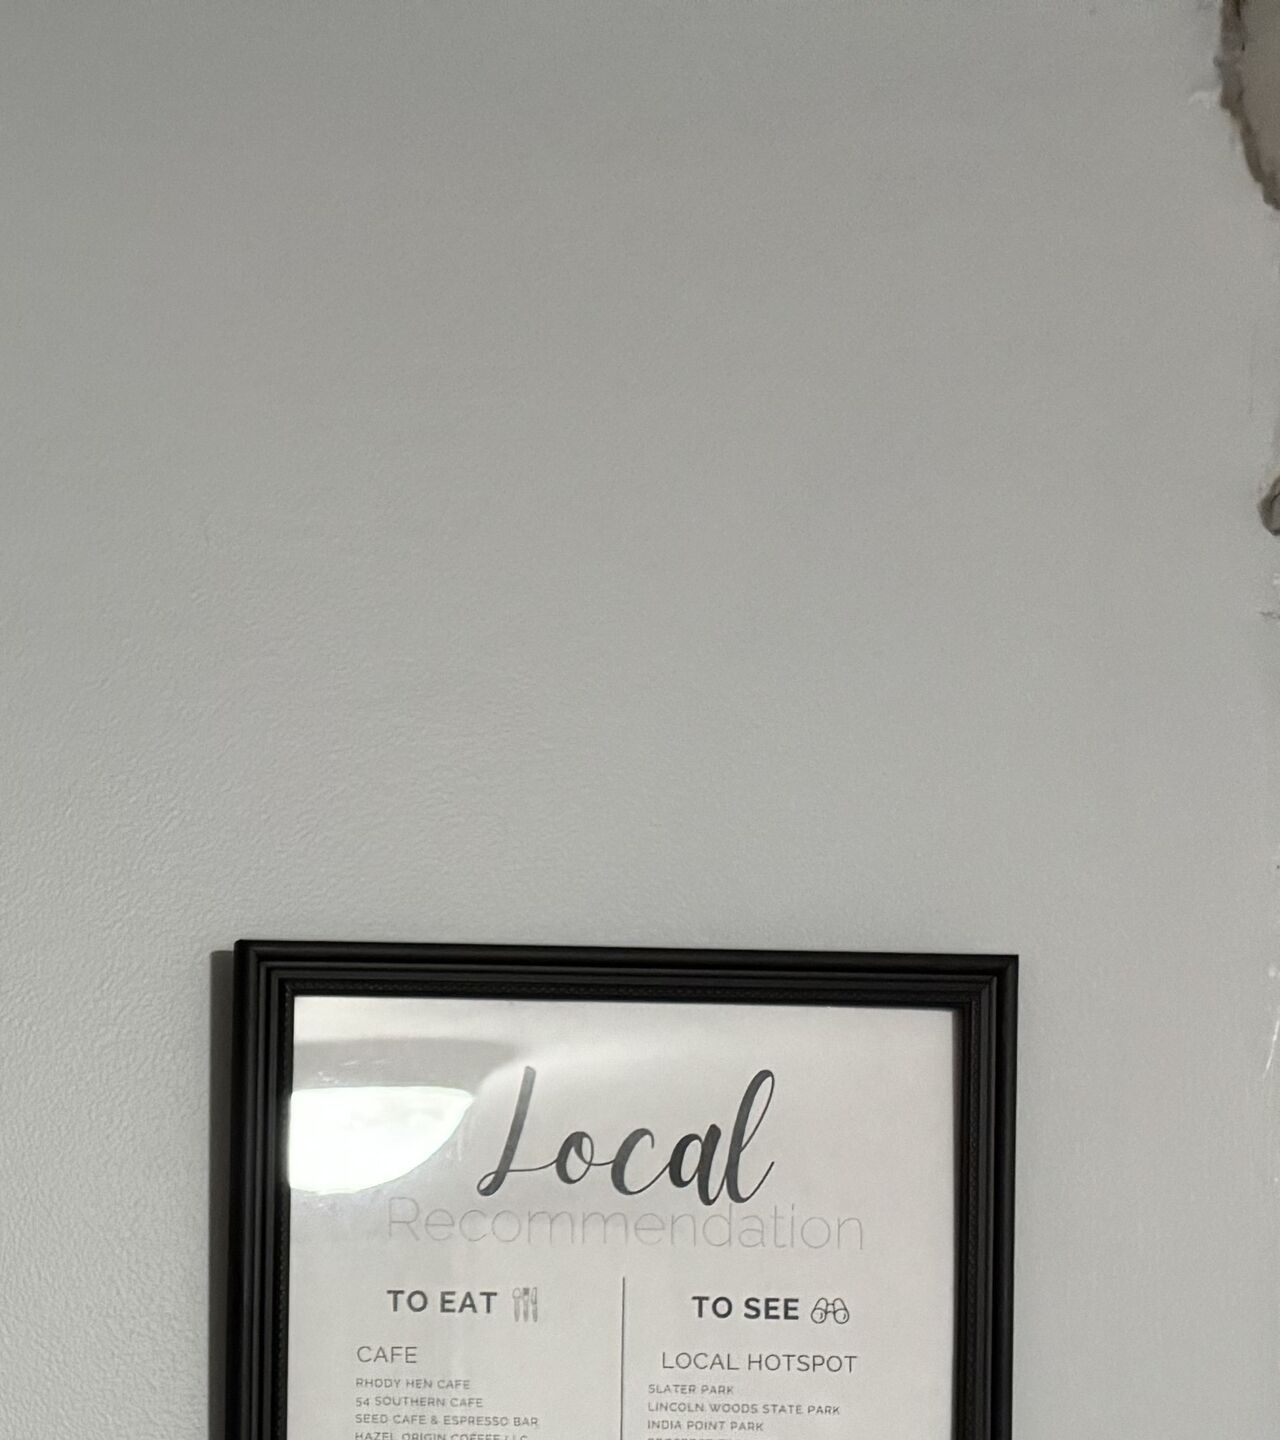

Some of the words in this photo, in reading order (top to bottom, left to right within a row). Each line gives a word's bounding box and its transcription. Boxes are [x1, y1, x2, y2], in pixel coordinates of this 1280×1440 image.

[477, 1066, 775, 1207] Local
[386, 1197, 865, 1250] Recommendation
[386, 1289, 429, 1313] TO
[439, 1290, 499, 1315] EAT
[690, 1295, 733, 1319] TO
[743, 1296, 800, 1321] SEE
[356, 1345, 418, 1364] CAFE
[662, 1351, 741, 1371] LOCAL
[747, 1353, 858, 1373] HOTSPOT
[355, 1377, 401, 1389] RHODY
[405, 1378, 433, 1389] HEN
[436, 1379, 470, 1390] CAFE
[648, 1383, 696, 1395] SLATER
[700, 1384, 734, 1395] PARK
[647, 1419, 682, 1430] INDIA
[686, 1420, 726, 1431] POINT
[730, 1421, 764, 1431] PARK
